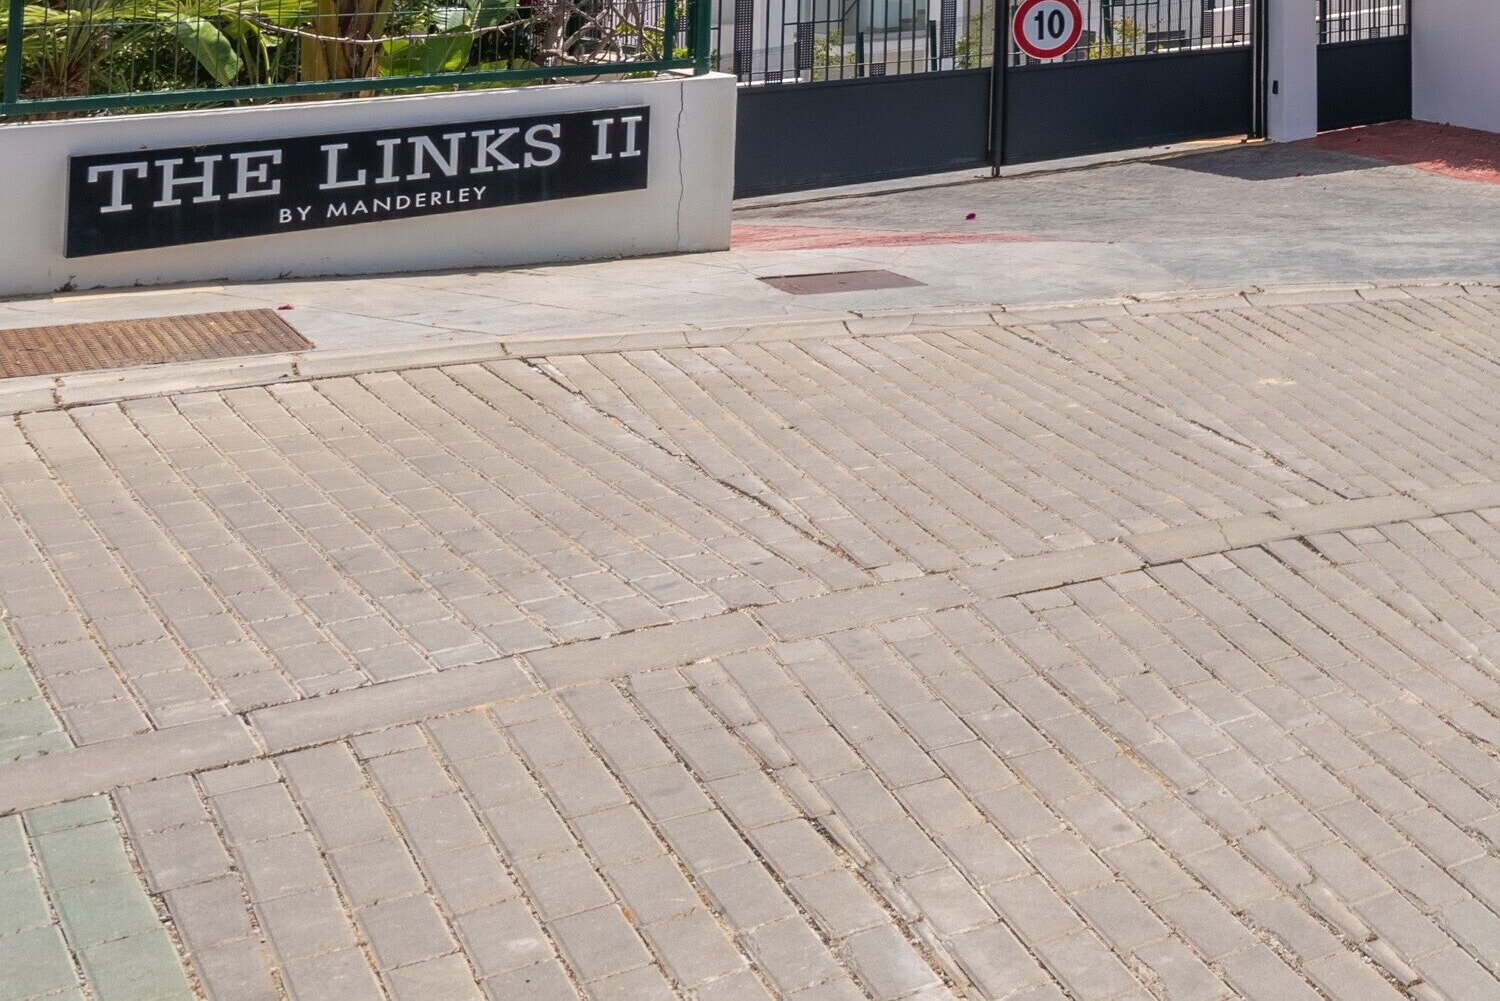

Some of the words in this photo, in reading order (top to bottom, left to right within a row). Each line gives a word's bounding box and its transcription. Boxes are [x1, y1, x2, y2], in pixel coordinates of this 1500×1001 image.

[1034, 9, 1065, 40] 10
[87, 149, 283, 213] THE
[318, 123, 562, 190] LINKS
[590, 115, 643, 161] II
[279, 205, 312, 224] BY
[326, 185, 488, 218] MANDERLEY
